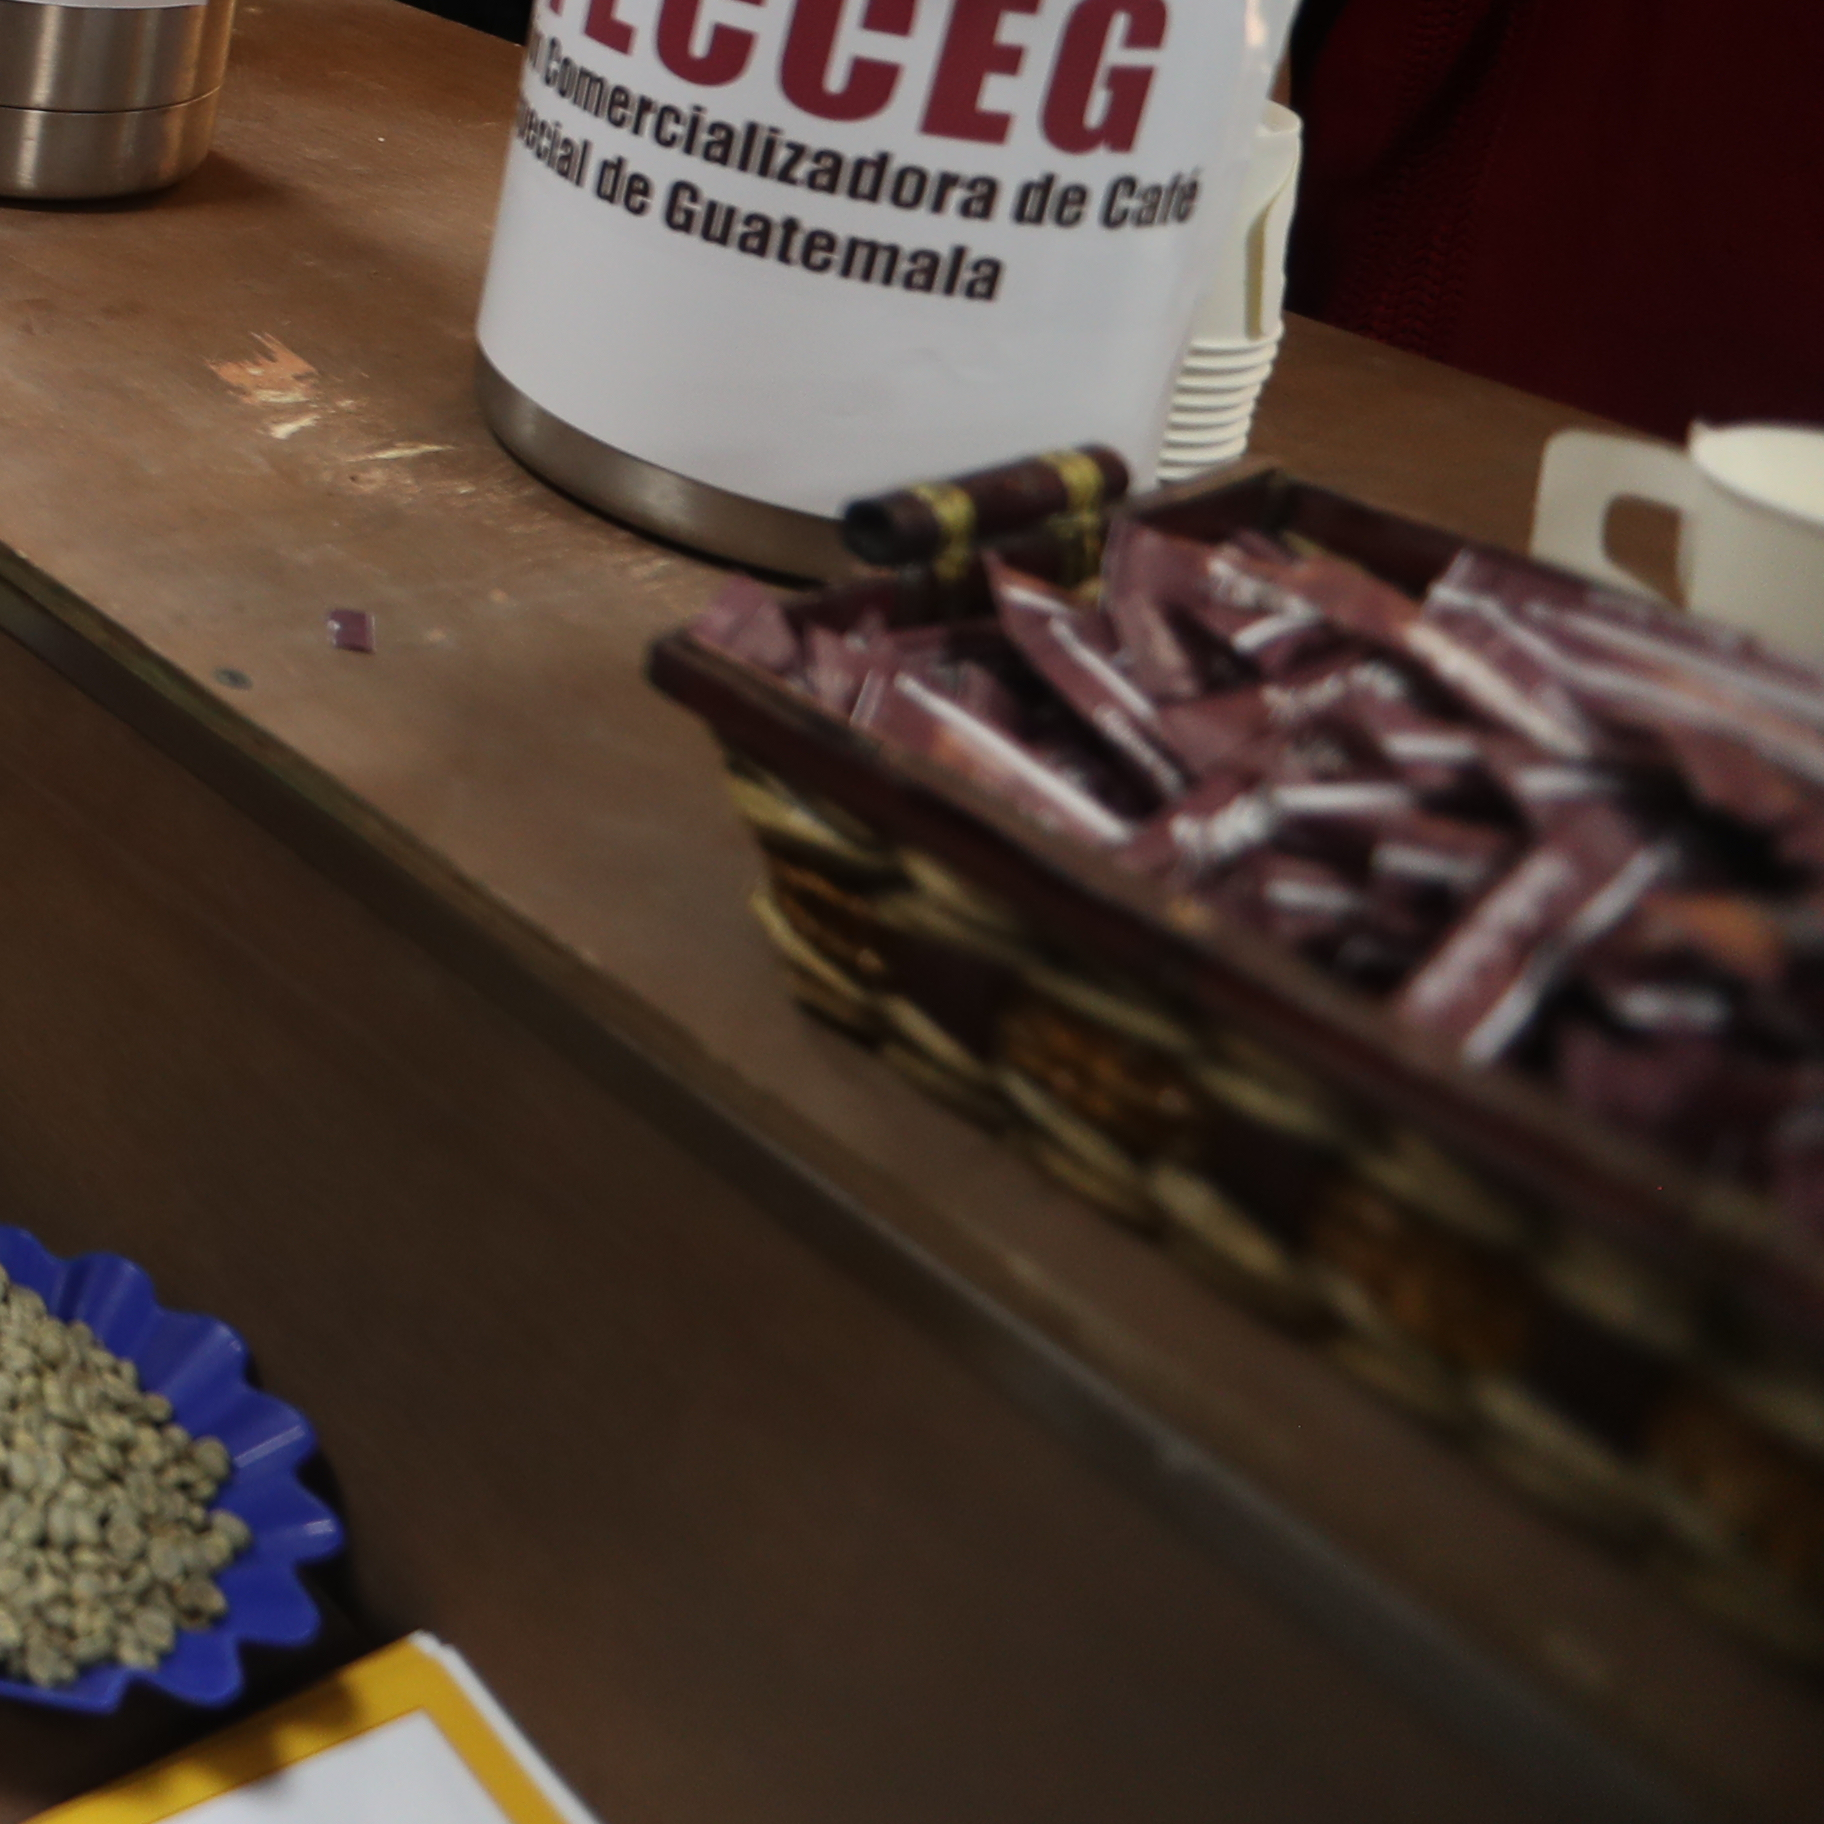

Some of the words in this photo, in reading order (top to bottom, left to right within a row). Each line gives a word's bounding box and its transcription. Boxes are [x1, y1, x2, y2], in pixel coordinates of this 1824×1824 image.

[544, 36, 1000, 225] Comercializadora
[1011, 170, 1090, 229] de
[1098, 163, 1204, 232] Café
[595, 154, 654, 218] de
[661, 179, 1008, 304] Guatemala
